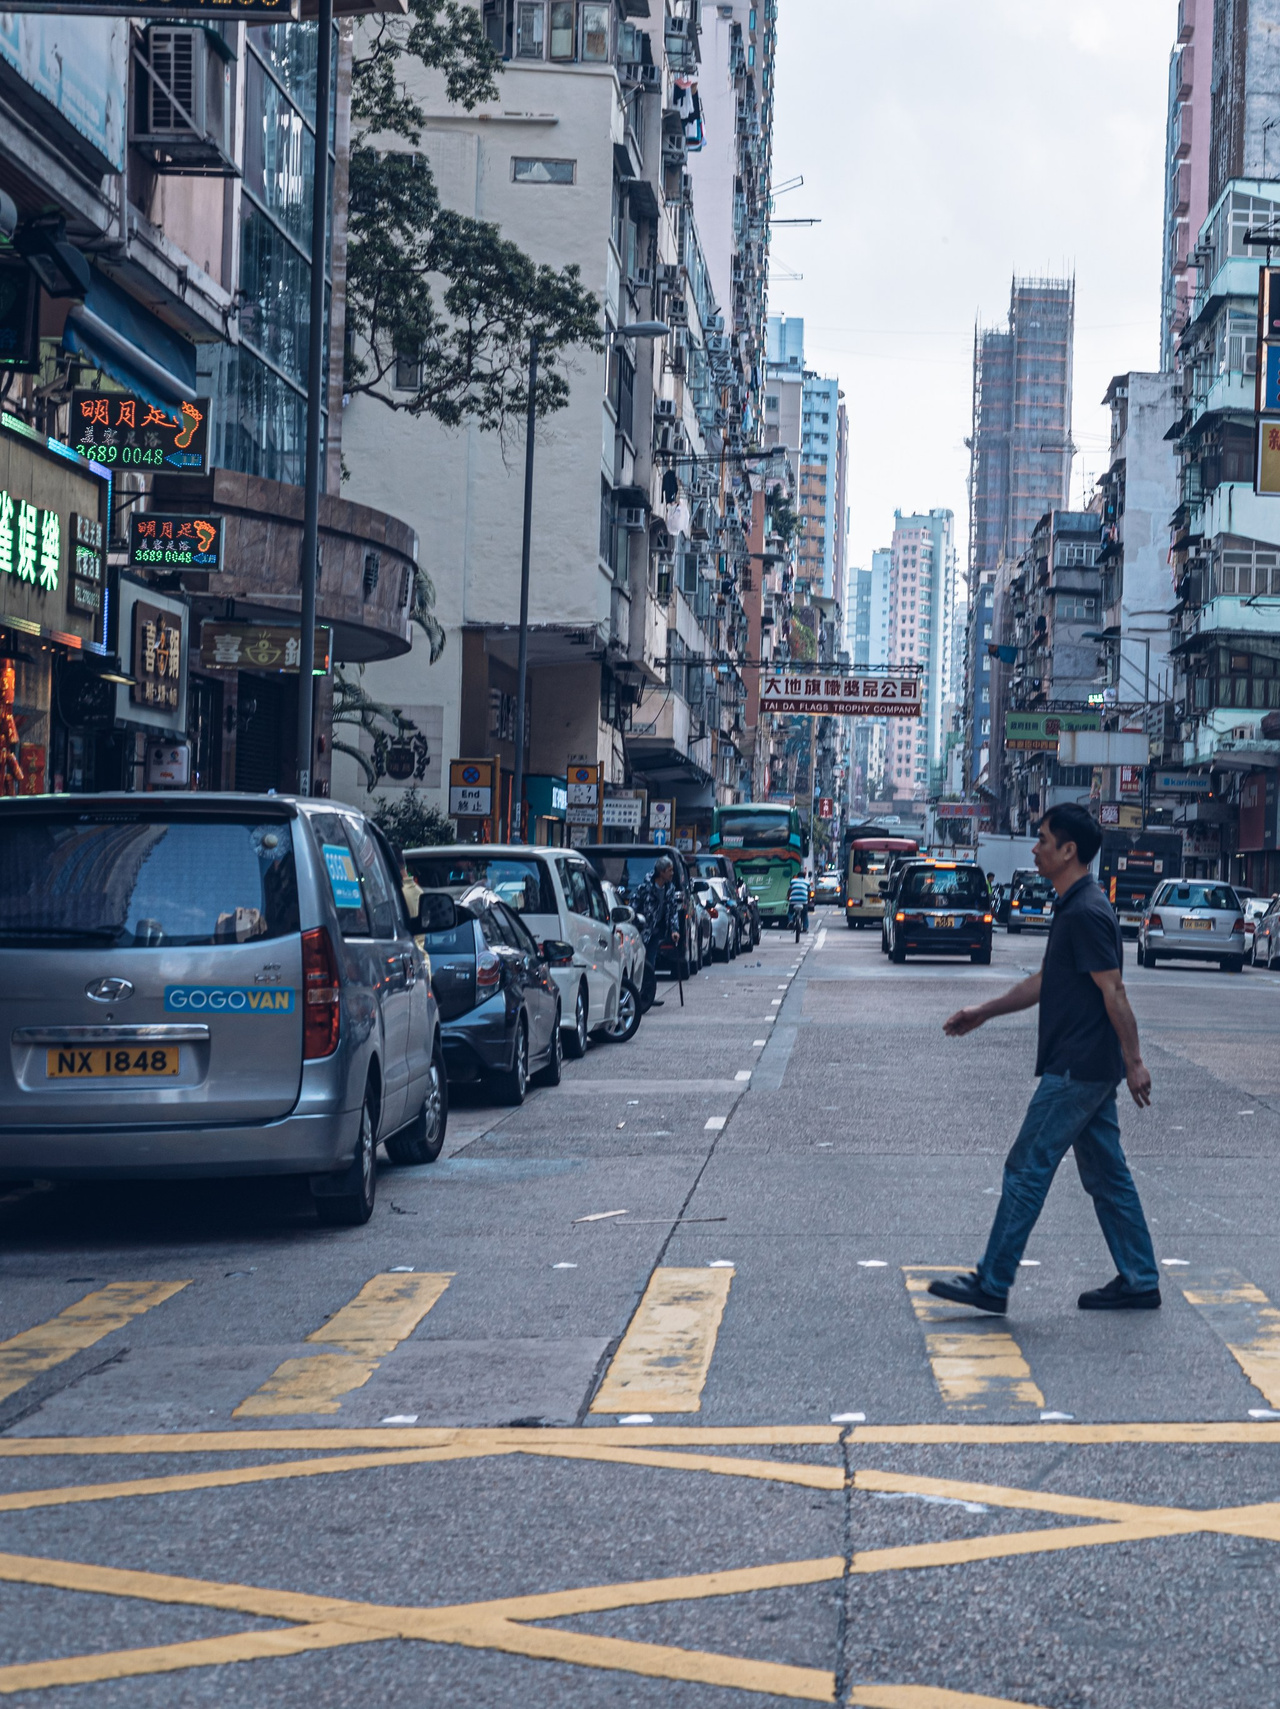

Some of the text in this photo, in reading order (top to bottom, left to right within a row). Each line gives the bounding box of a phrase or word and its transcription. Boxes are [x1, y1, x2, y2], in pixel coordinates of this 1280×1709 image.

[122, 447, 164, 466] 0048
[135, 549, 163, 563] 3689
[164, 550, 192, 564] 0048
[764, 702, 917, 715] TAI DA FLAGS TROPHY COMPANY
[1170, 776, 1208, 787] karrimor
[461, 790, 480, 799] End
[457, 801, 483, 812] 終止
[169, 989, 290, 1010] GOGOVAN
[58, 1050, 167, 1073] NX 1848
